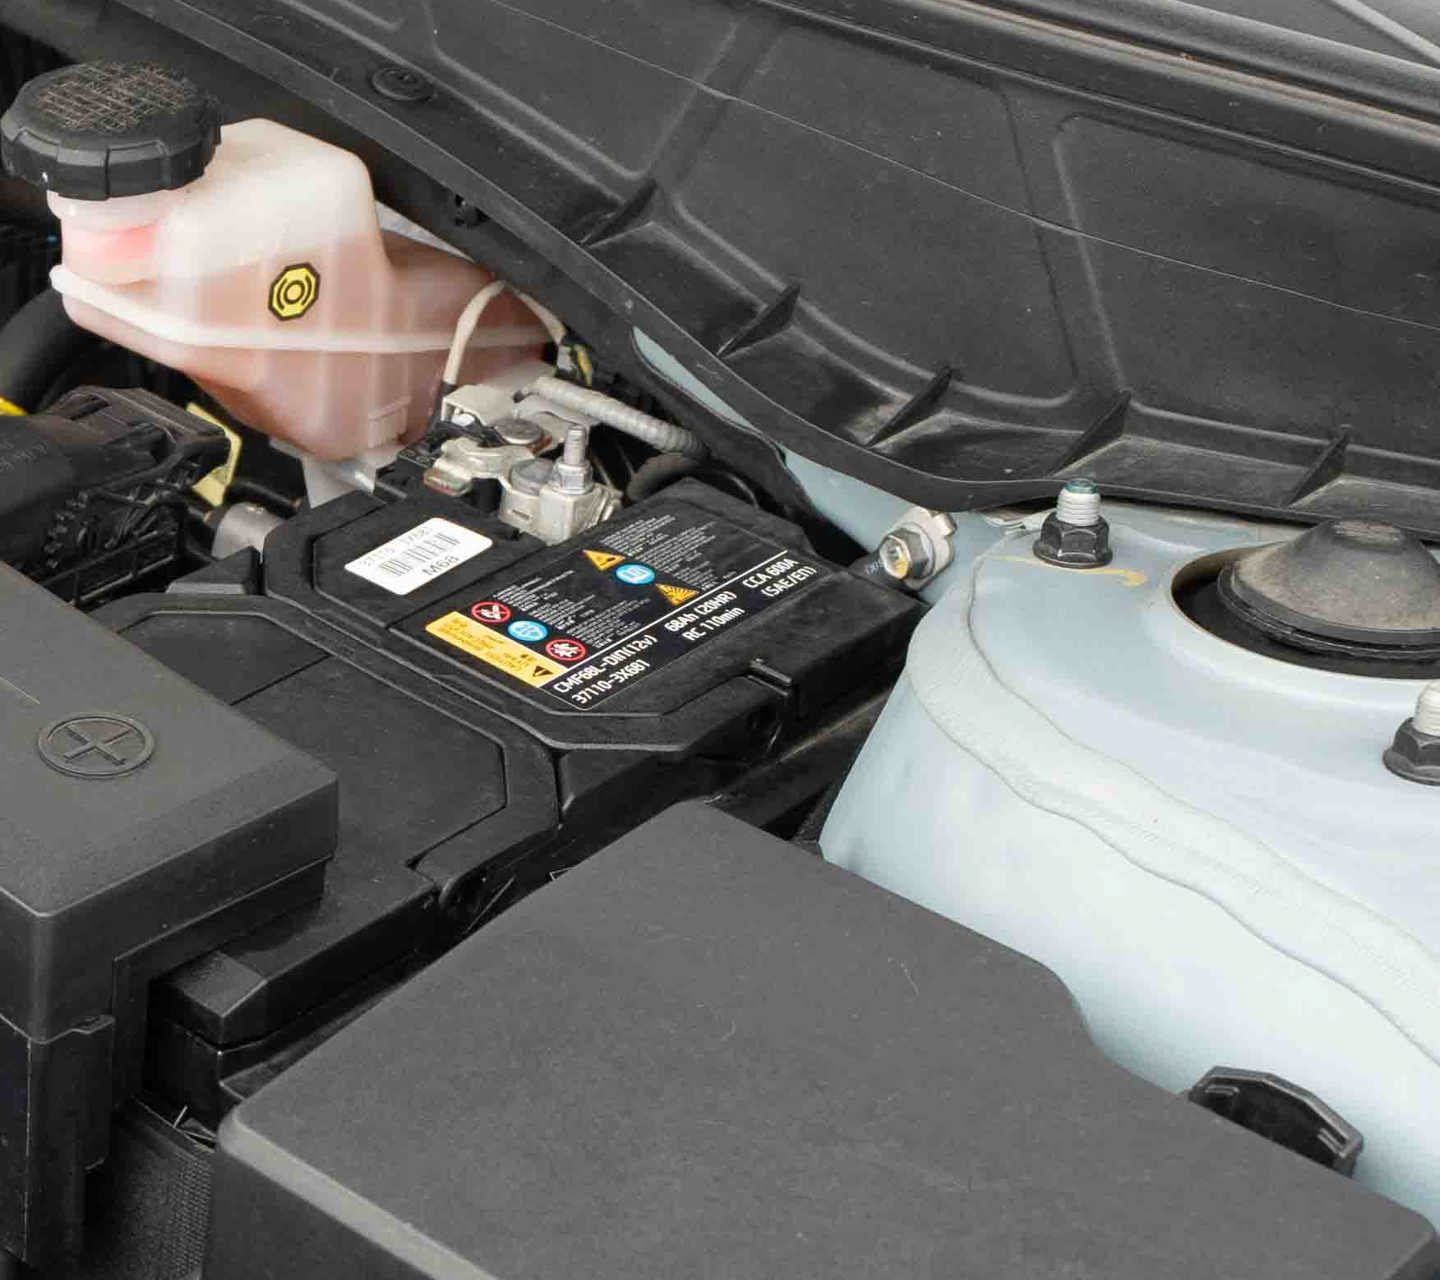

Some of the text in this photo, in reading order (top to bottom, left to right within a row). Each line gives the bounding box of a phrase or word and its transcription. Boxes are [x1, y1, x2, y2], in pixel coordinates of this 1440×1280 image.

[664, 612, 701, 633] 68Ah
[693, 591, 738, 619] (20HR)
[742, 573, 771, 590] CCA
[682, 623, 707, 642] RC
[701, 606, 745, 632] 110min
